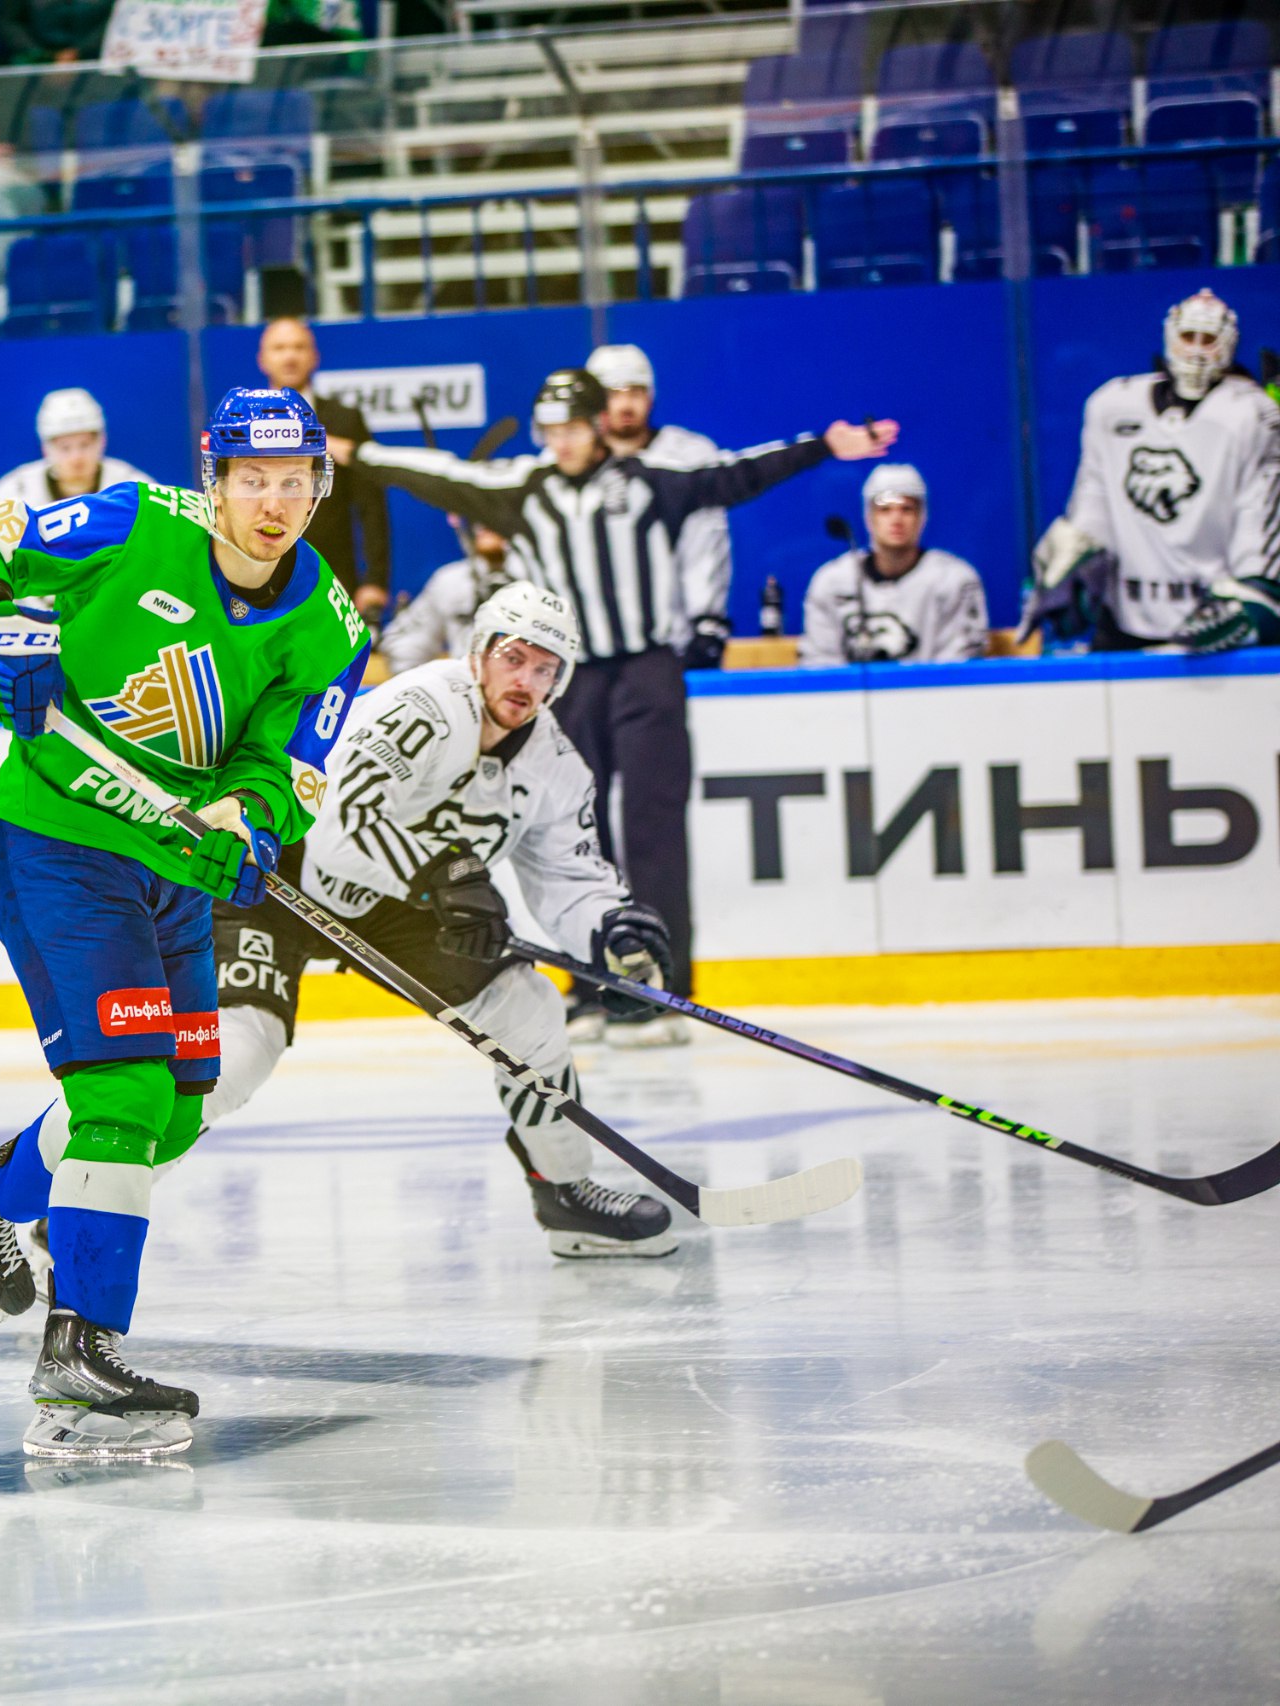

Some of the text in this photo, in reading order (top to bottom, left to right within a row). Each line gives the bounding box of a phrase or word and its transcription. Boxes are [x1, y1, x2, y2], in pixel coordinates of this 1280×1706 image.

[253, 428, 300, 440] согаз
[32, 495, 91, 543] 6
[153, 597, 180, 614] МИР
[315, 685, 346, 740] 8
[376, 702, 436, 760] 40
[701, 756, 1280, 882] ТИНЬ
[265, 873, 348, 941] SPEED
[218, 960, 290, 1002] ЮГК
[110, 1001, 160, 1021] Альфа
[176, 1026, 210, 1046] льфа
[436, 1007, 572, 1109] CCM
[936, 1094, 1066, 1150] CCM
